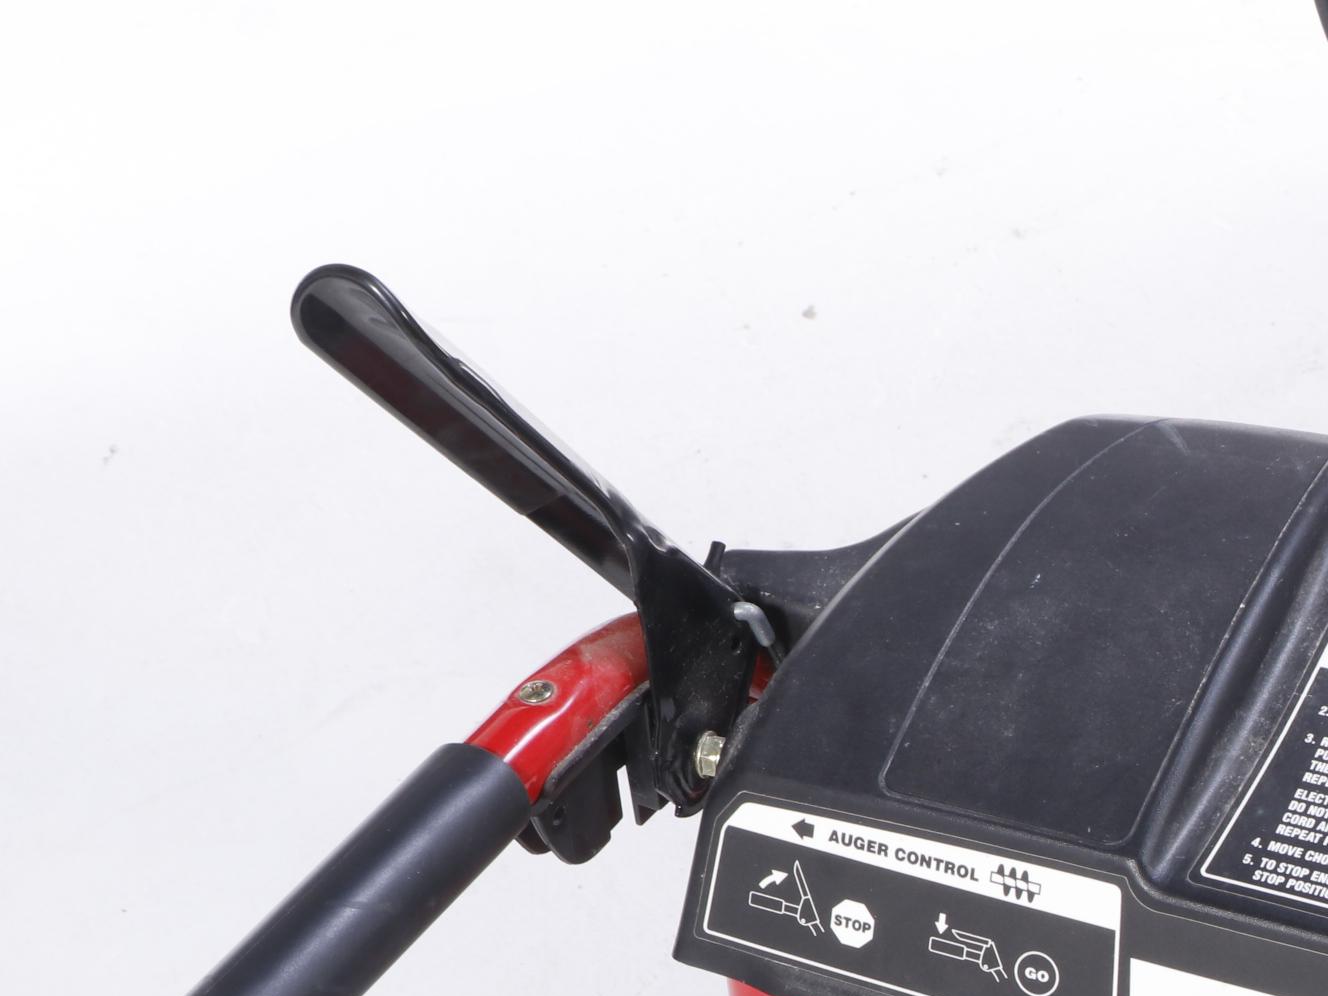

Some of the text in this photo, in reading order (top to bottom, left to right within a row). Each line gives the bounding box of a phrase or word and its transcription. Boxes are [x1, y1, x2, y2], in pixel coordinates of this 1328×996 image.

[1318, 705, 1328, 716] 2.
[1304, 733, 1315, 744] 3.
[1287, 800, 1306, 812] DO
[1282, 812, 1315, 828] CORD
[1275, 823, 1323, 843] REPEAT
[828, 830, 978, 881] AUGER CONTROL
[1250, 837, 1262, 848] 4.
[1267, 840, 1304, 858] MOVE
[1242, 853, 1253, 865] 5.
[1260, 857, 1276, 870] TO
[1276, 862, 1309, 877] STOP
[1252, 869, 1285, 885] STOP
[834, 914, 871, 932] STOP
[1024, 967, 1049, 982] GO
